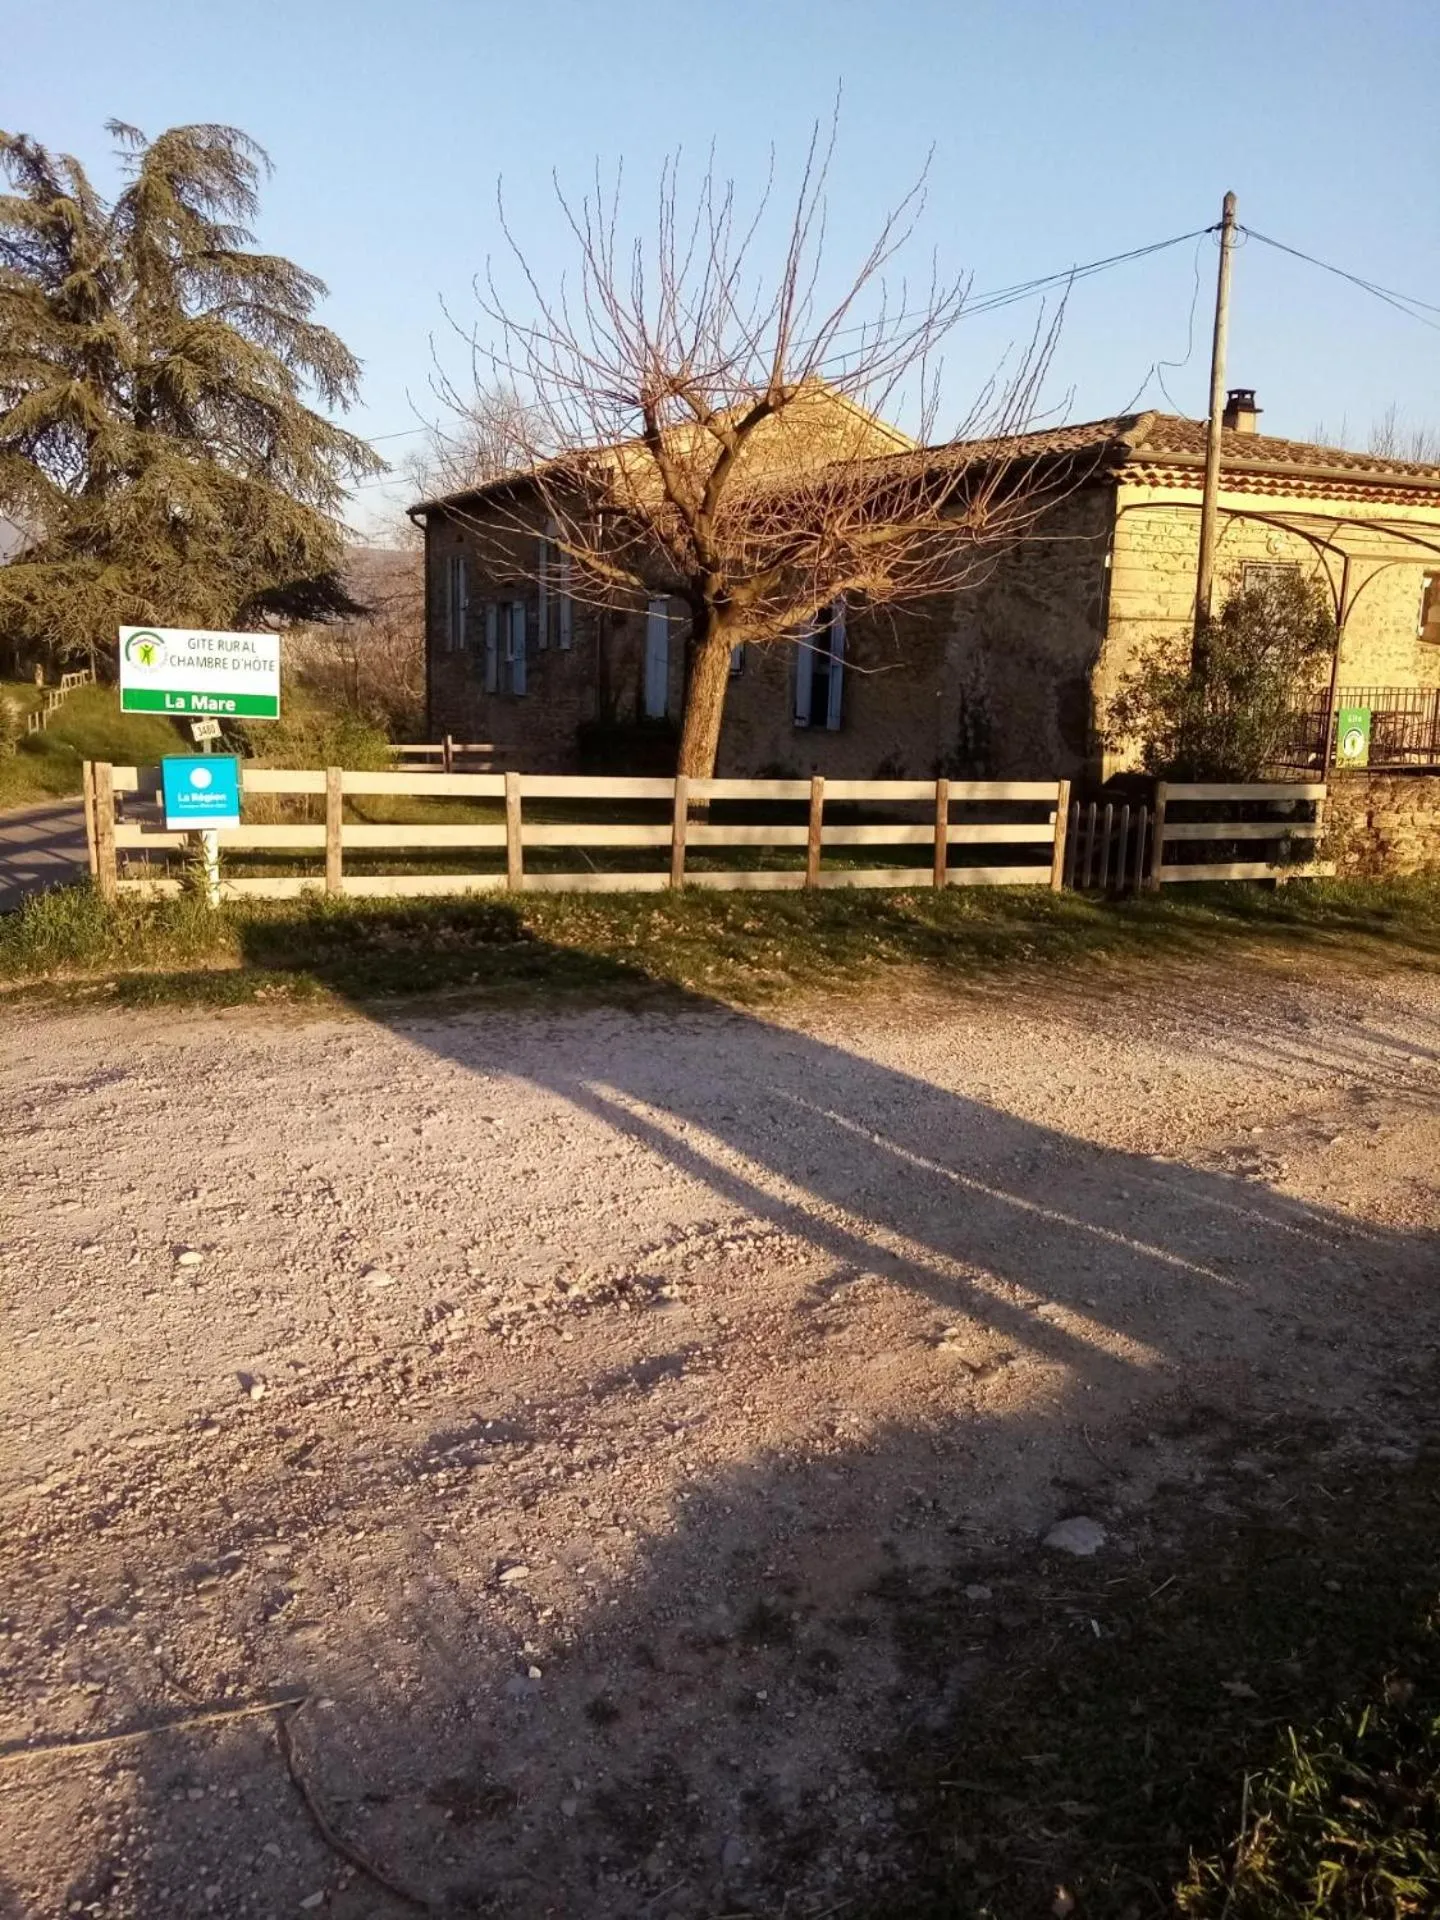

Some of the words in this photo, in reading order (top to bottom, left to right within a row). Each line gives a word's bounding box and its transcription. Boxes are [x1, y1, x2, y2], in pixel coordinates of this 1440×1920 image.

[218, 639, 257, 654] RURAL
[170, 655, 229, 669] CHAMBRE
[232, 656, 275, 672] D'HÔTE
[165, 693, 186, 709] La
[191, 695, 236, 712] Mare
[177, 792, 190, 802] La
